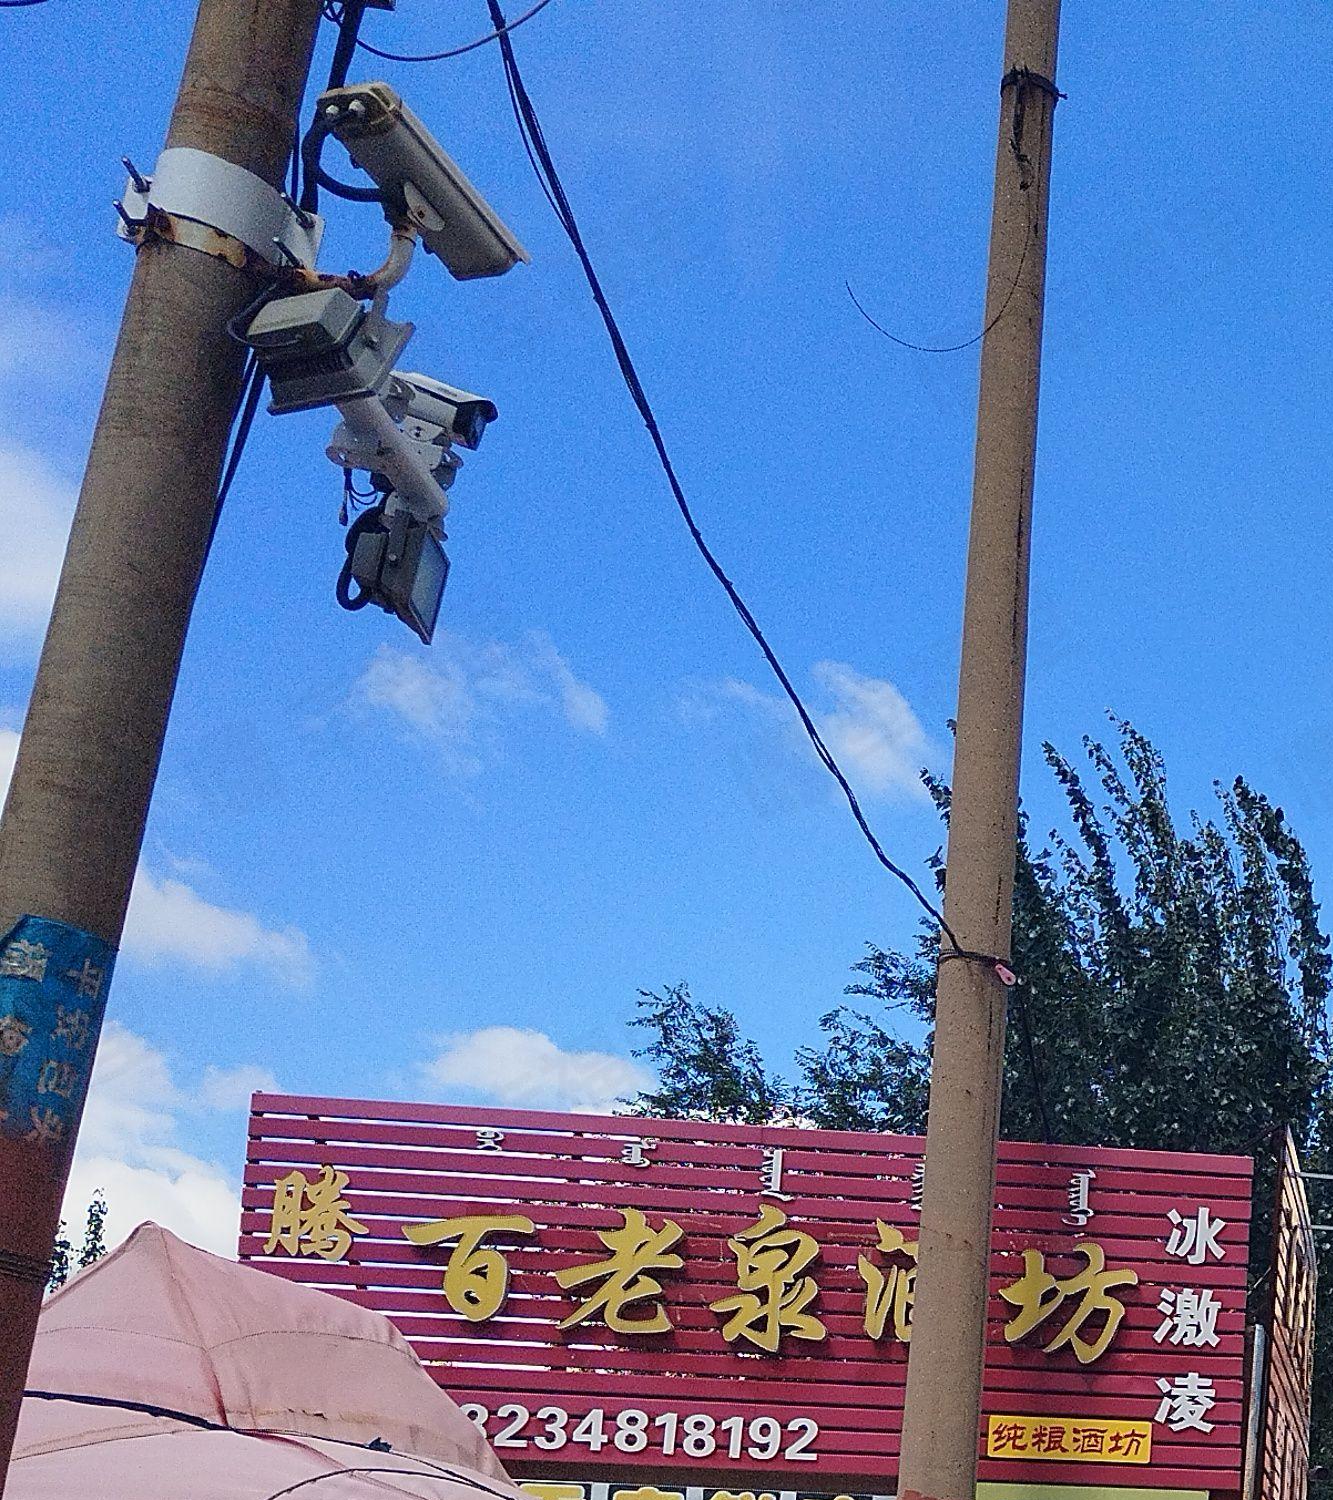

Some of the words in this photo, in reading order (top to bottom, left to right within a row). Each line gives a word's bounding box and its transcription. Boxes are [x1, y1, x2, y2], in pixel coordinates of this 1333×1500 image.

[262, 1165, 369, 1262] 腾
[1152, 1206, 1226, 1434] 冰激凌
[991, 1422, 1148, 1457] 纯粮酒坊
